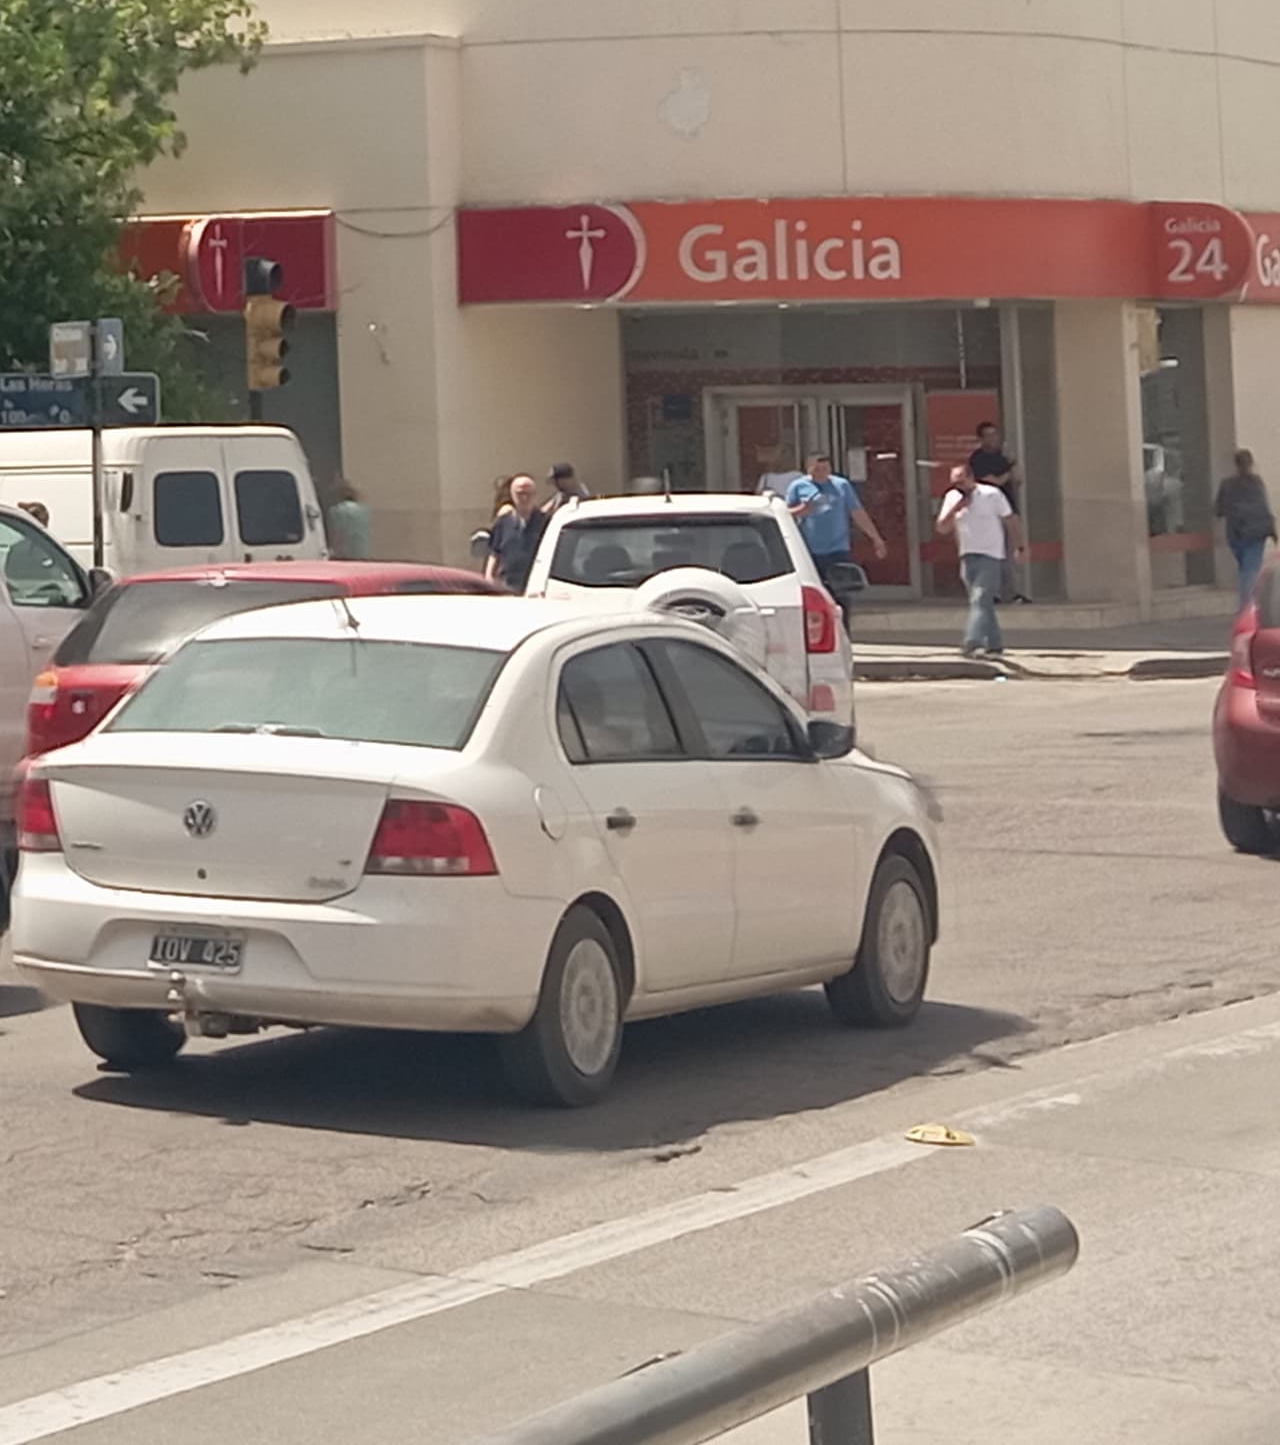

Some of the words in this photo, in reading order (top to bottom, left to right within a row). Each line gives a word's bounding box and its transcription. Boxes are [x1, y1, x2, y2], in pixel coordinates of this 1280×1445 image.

[1164, 217, 1221, 233] Galicia
[678, 218, 902, 282] Galicia
[1167, 237, 1228, 282] 24
